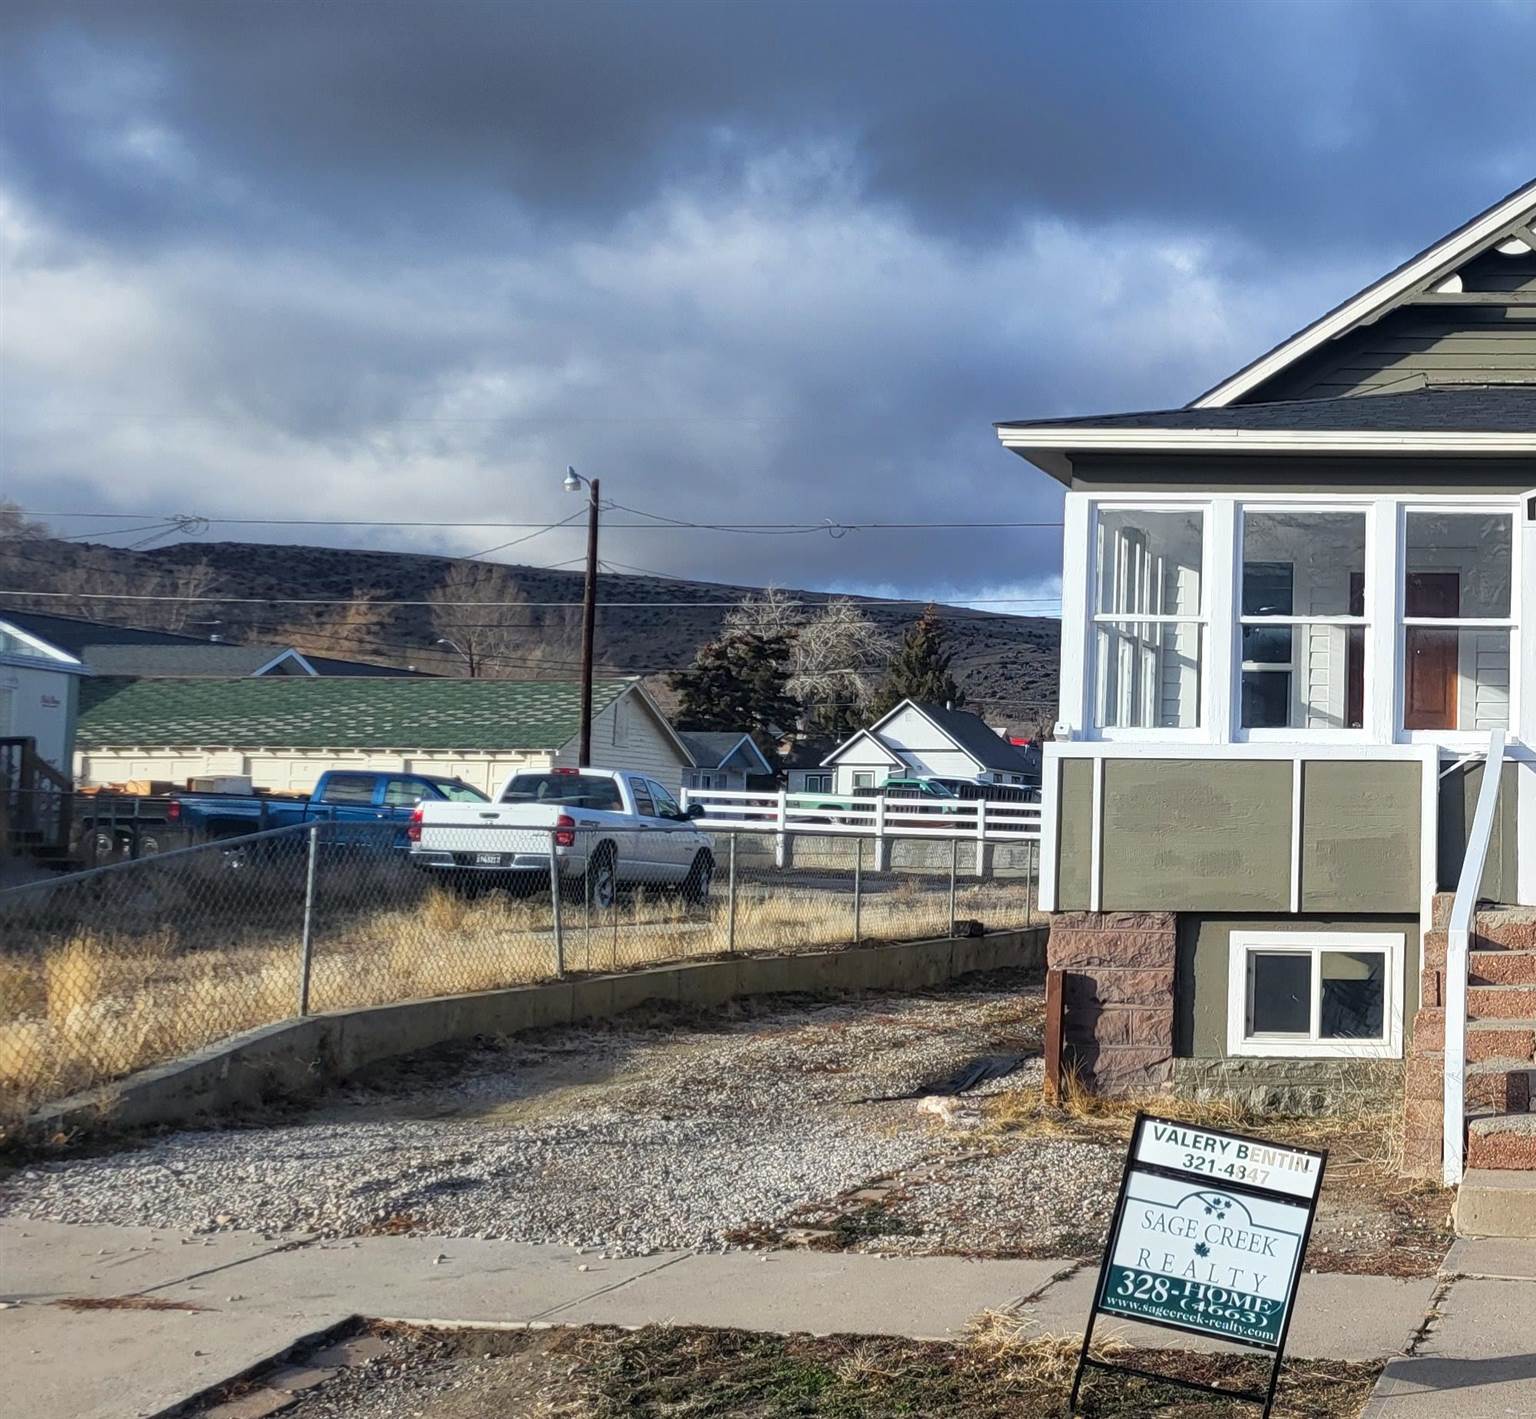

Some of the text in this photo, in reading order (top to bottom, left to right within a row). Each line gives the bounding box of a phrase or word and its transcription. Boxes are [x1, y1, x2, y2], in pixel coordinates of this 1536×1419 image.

[1153, 1126, 1231, 1154] VALERY
[1182, 1154, 1270, 1185] 321-4847
[1142, 1210, 1279, 1257] SAGE CREEK
[1137, 1248, 1267, 1293] REALTY
[1117, 1271, 1274, 1314] 328-HOME
[1180, 1298, 1268, 1327] (4663)
[1106, 1296, 1274, 1340] www.sagecreek-realty.com
